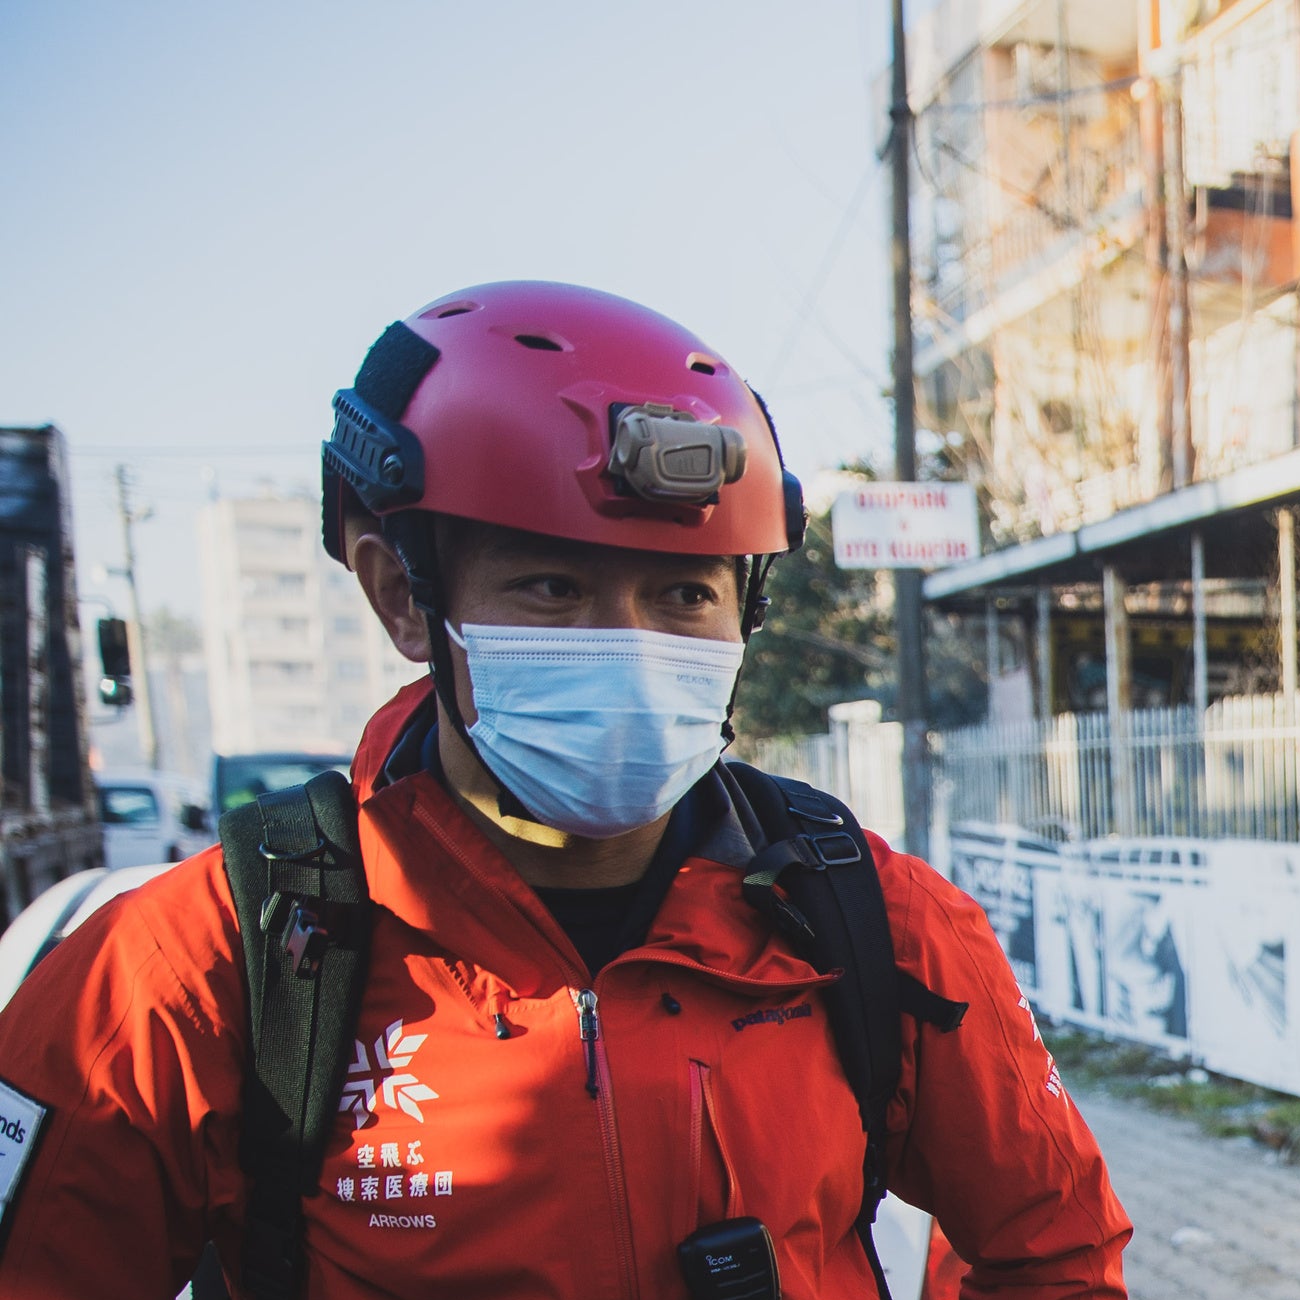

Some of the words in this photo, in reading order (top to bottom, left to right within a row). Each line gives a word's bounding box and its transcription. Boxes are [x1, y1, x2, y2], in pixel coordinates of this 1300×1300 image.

[357, 1140, 425, 1169] 空飛ぶ
[337, 1170, 453, 1202] 捜索医療団
[369, 1213, 437, 1229] ARROWS
